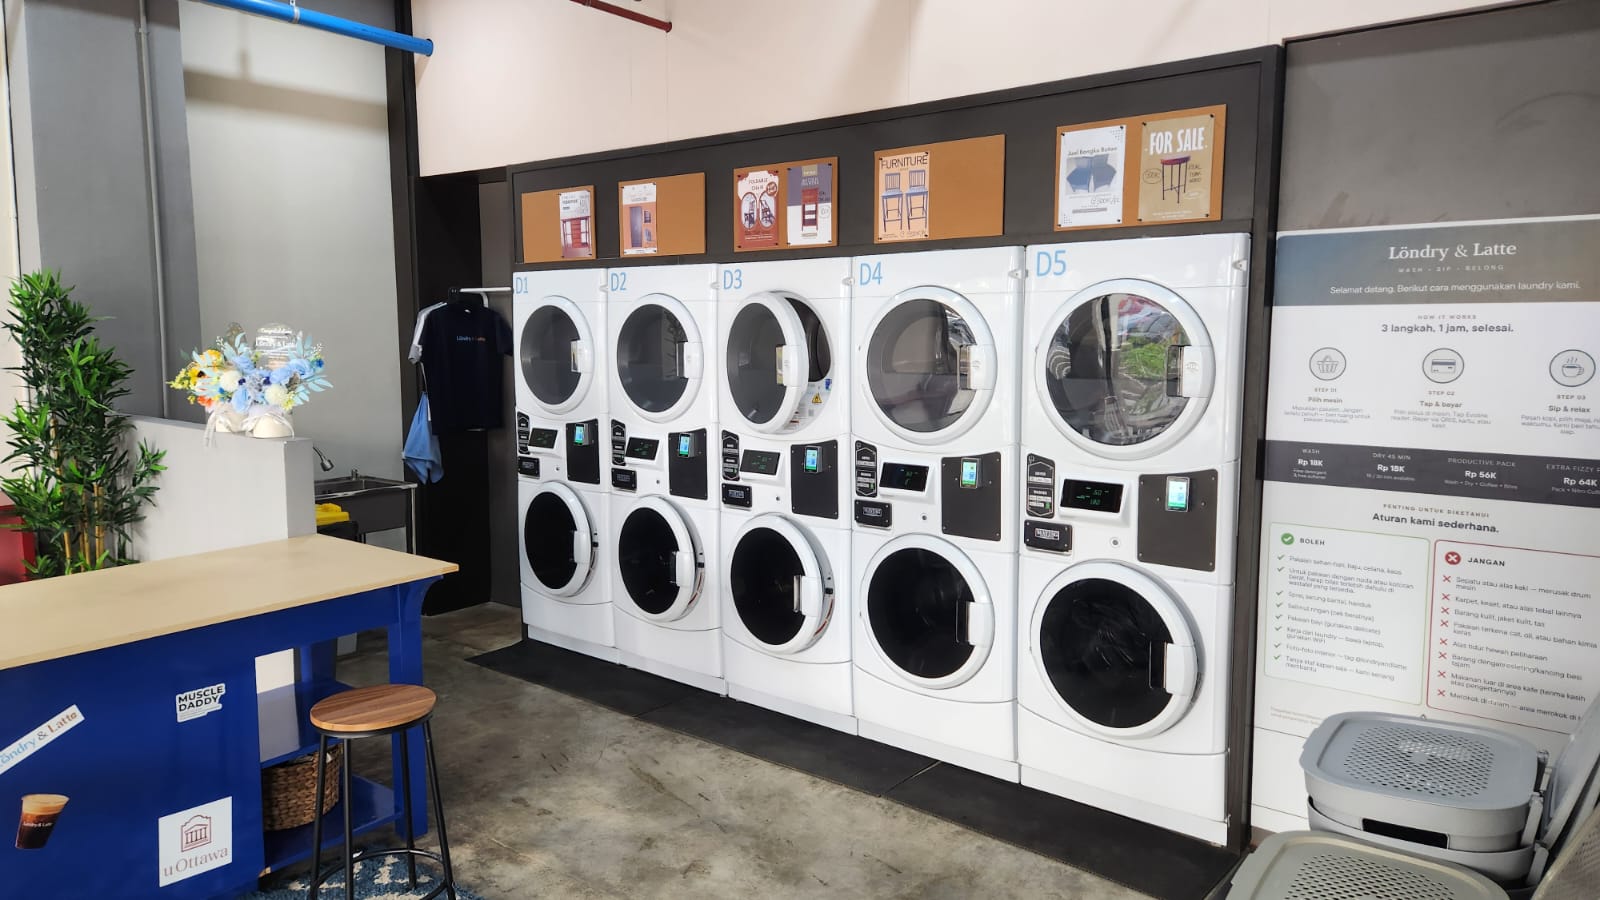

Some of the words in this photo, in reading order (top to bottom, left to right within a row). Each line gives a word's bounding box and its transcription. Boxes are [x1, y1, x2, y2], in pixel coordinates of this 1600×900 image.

[1149, 131, 1173, 155] FOR
[1176, 127, 1205, 153] SALE
[880, 154, 928, 170] FURNITURE
[1388, 244, 1449, 261] Löndry
[1455, 244, 1469, 258] &
[1472, 242, 1517, 256] Latte
[1036, 249, 1067, 277] D5
[610, 272, 627, 291] D2
[723, 269, 743, 290] D3
[859, 261, 883, 286] D4
[515, 276, 528, 294] D1
[1330, 286, 1363, 294] Selamat
[1364, 285, 1395, 295] datang.
[1397, 283, 1428, 293] Berikut
[1450, 282, 1516, 292] menggunakan
[1517, 280, 1554, 291] laundry
[1556, 281, 1581, 289] kami.
[1381, 324, 1388, 332] 3
[1439, 324, 1443, 332] 1
[1445, 323, 1469, 334] jam,
[1471, 323, 1514, 332] selesai.
[1420, 401, 1434, 409] Tap
[1441, 401, 1463, 409] bayar
[1548, 405, 1562, 413] Sip
[1298, 458, 1309, 467] Rp
[1377, 464, 1389, 473] Rp
[1447, 457, 1494, 466] PRODUCTIVE
[1546, 463, 1570, 471] EXTRA
[1572, 465, 1594, 473] FIZZY
[1464, 470, 1478, 479] Rp
[1479, 471, 1497, 479] 56K
[1563, 477, 1577, 486] Rp
[1578, 478, 1597, 487] 64K
[1447, 509, 1490, 518] DIKETAHUI
[1372, 513, 1408, 524] Aturan
[1410, 516, 1435, 527] kami
[1438, 519, 1500, 533] sederhana.
[1300, 537, 1325, 546] BOLEH
[1468, 557, 1506, 567] JANGAN
[1332, 572, 1356, 583] dengan
[1373, 578, 1388, 586] atau
[1456, 576, 1481, 586] Sepatu
[1500, 582, 1513, 590] alas
[1514, 583, 1529, 591] kaki
[1538, 587, 1570, 597] merusak
[1570, 590, 1591, 599] drum
[1455, 596, 1479, 606] Karpet,
[1480, 600, 1501, 608] keset,
[1519, 604, 1534, 612] alas
[1535, 606, 1554, 615] tebal
[1555, 609, 1582, 620] lainnya
[1454, 609, 1479, 619] Barang
[1480, 612, 1497, 620] kulit,
[1497, 614, 1515, 623] jaket
[1516, 617, 1533, 626] kulit,
[1453, 622, 1480, 632] Pakaian
[1481, 625, 1508, 635] terkena
[1509, 629, 1523, 638] cat,
[1523, 631, 1534, 639] oli,
[1535, 634, 1551, 642] atau
[1553, 635, 1577, 645] bahan
[1578, 639, 1598, 649] kimia
[1452, 641, 1467, 649] Alas
[1468, 643, 1484, 652] tidur
[1485, 645, 1510, 655] hewan
[1510, 648, 1548, 661] peliharaan
[1452, 654, 1476, 664] Barang
[1477, 658, 1504, 669] dengan
[1566, 672, 1583, 681] besi
[1450, 679, 1465, 687] atas
[1450, 673, 1482, 684] Makanan
[1483, 676, 1497, 686] luar
[1505, 683, 1522, 691] area
[1523, 684, 1539, 694] kafe
[1539, 687, 1566, 699] (terima
[1566, 691, 1586, 702] kasih
[178, 685, 224, 704] MUSCLE
[178, 695, 219, 712] DADDY
[1450, 692, 1479, 703] Merokok
[1519, 705, 1535, 713] area
[1536, 707, 1568, 720] merokok
[1569, 712, 1577, 721] di
[37, 731, 49, 741] &
[47, 712, 78, 733] Latte
